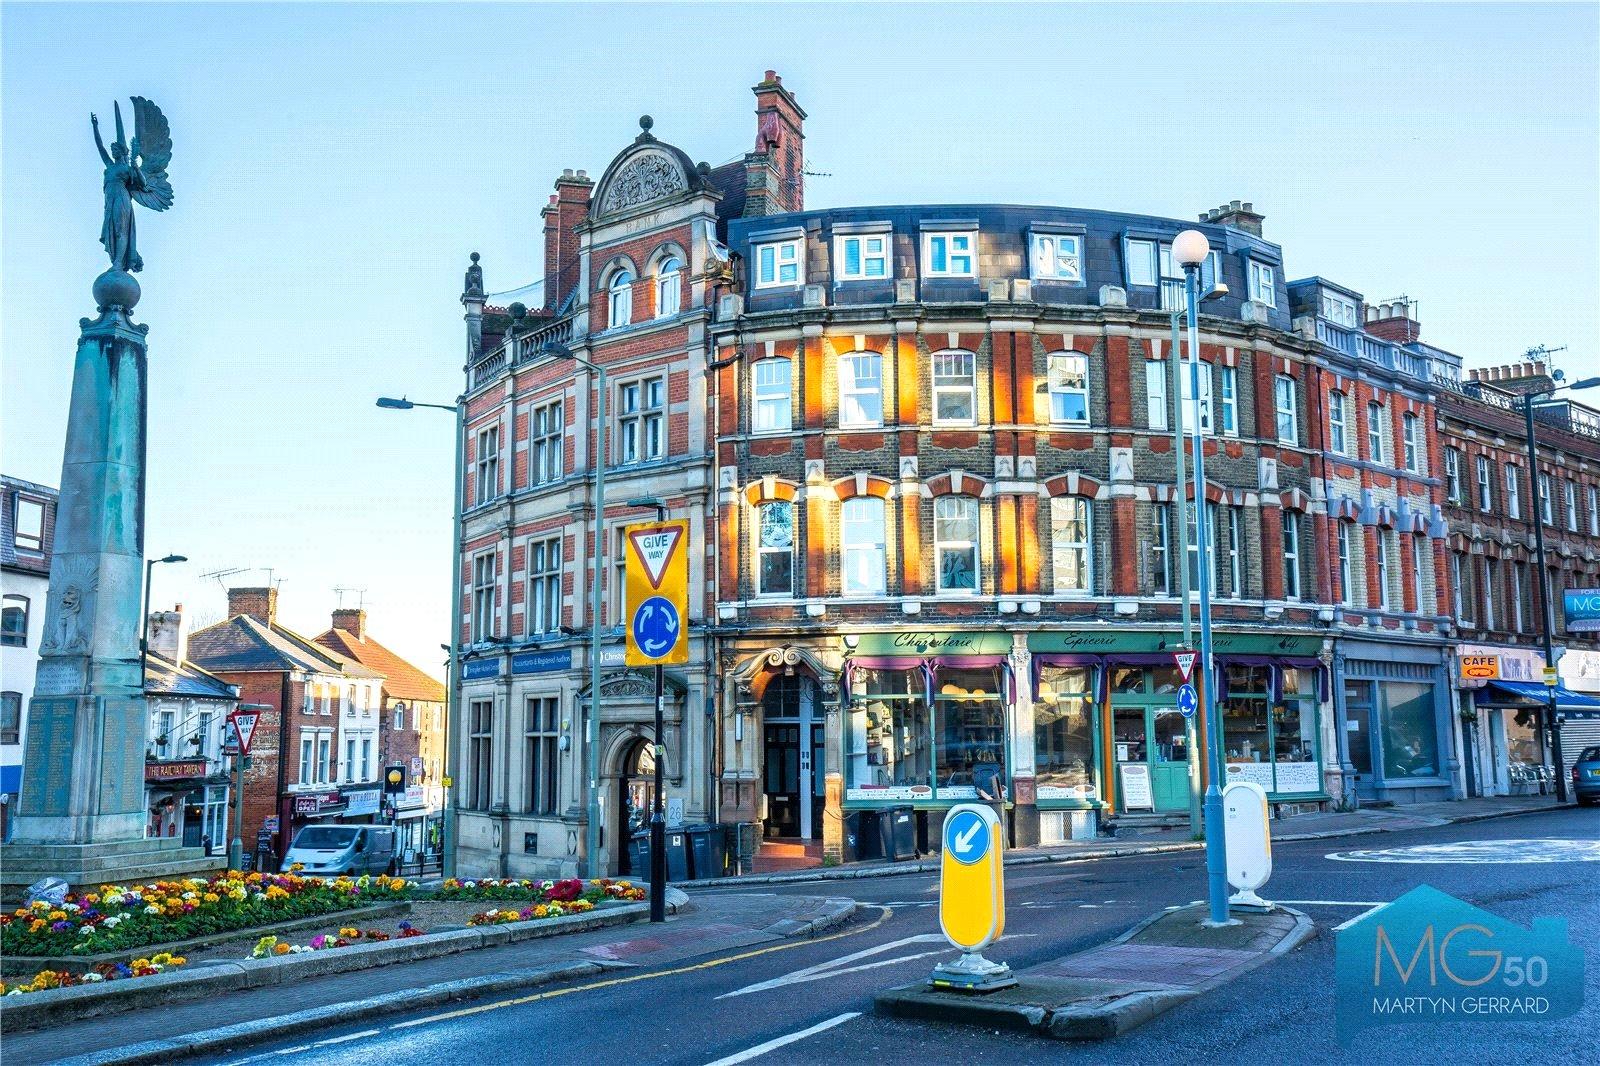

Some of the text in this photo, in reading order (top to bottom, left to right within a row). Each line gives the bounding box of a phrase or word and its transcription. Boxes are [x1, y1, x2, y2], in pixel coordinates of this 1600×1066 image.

[643, 535, 668, 548] GIVE
[648, 550, 664, 559] WAY
[1064, 631, 1116, 649] Epicerie
[1178, 654, 1192, 662] GIVE
[1463, 657, 1495, 666] CAFE
[237, 716, 253, 726] GIVE
[669, 806, 682, 820] 26
